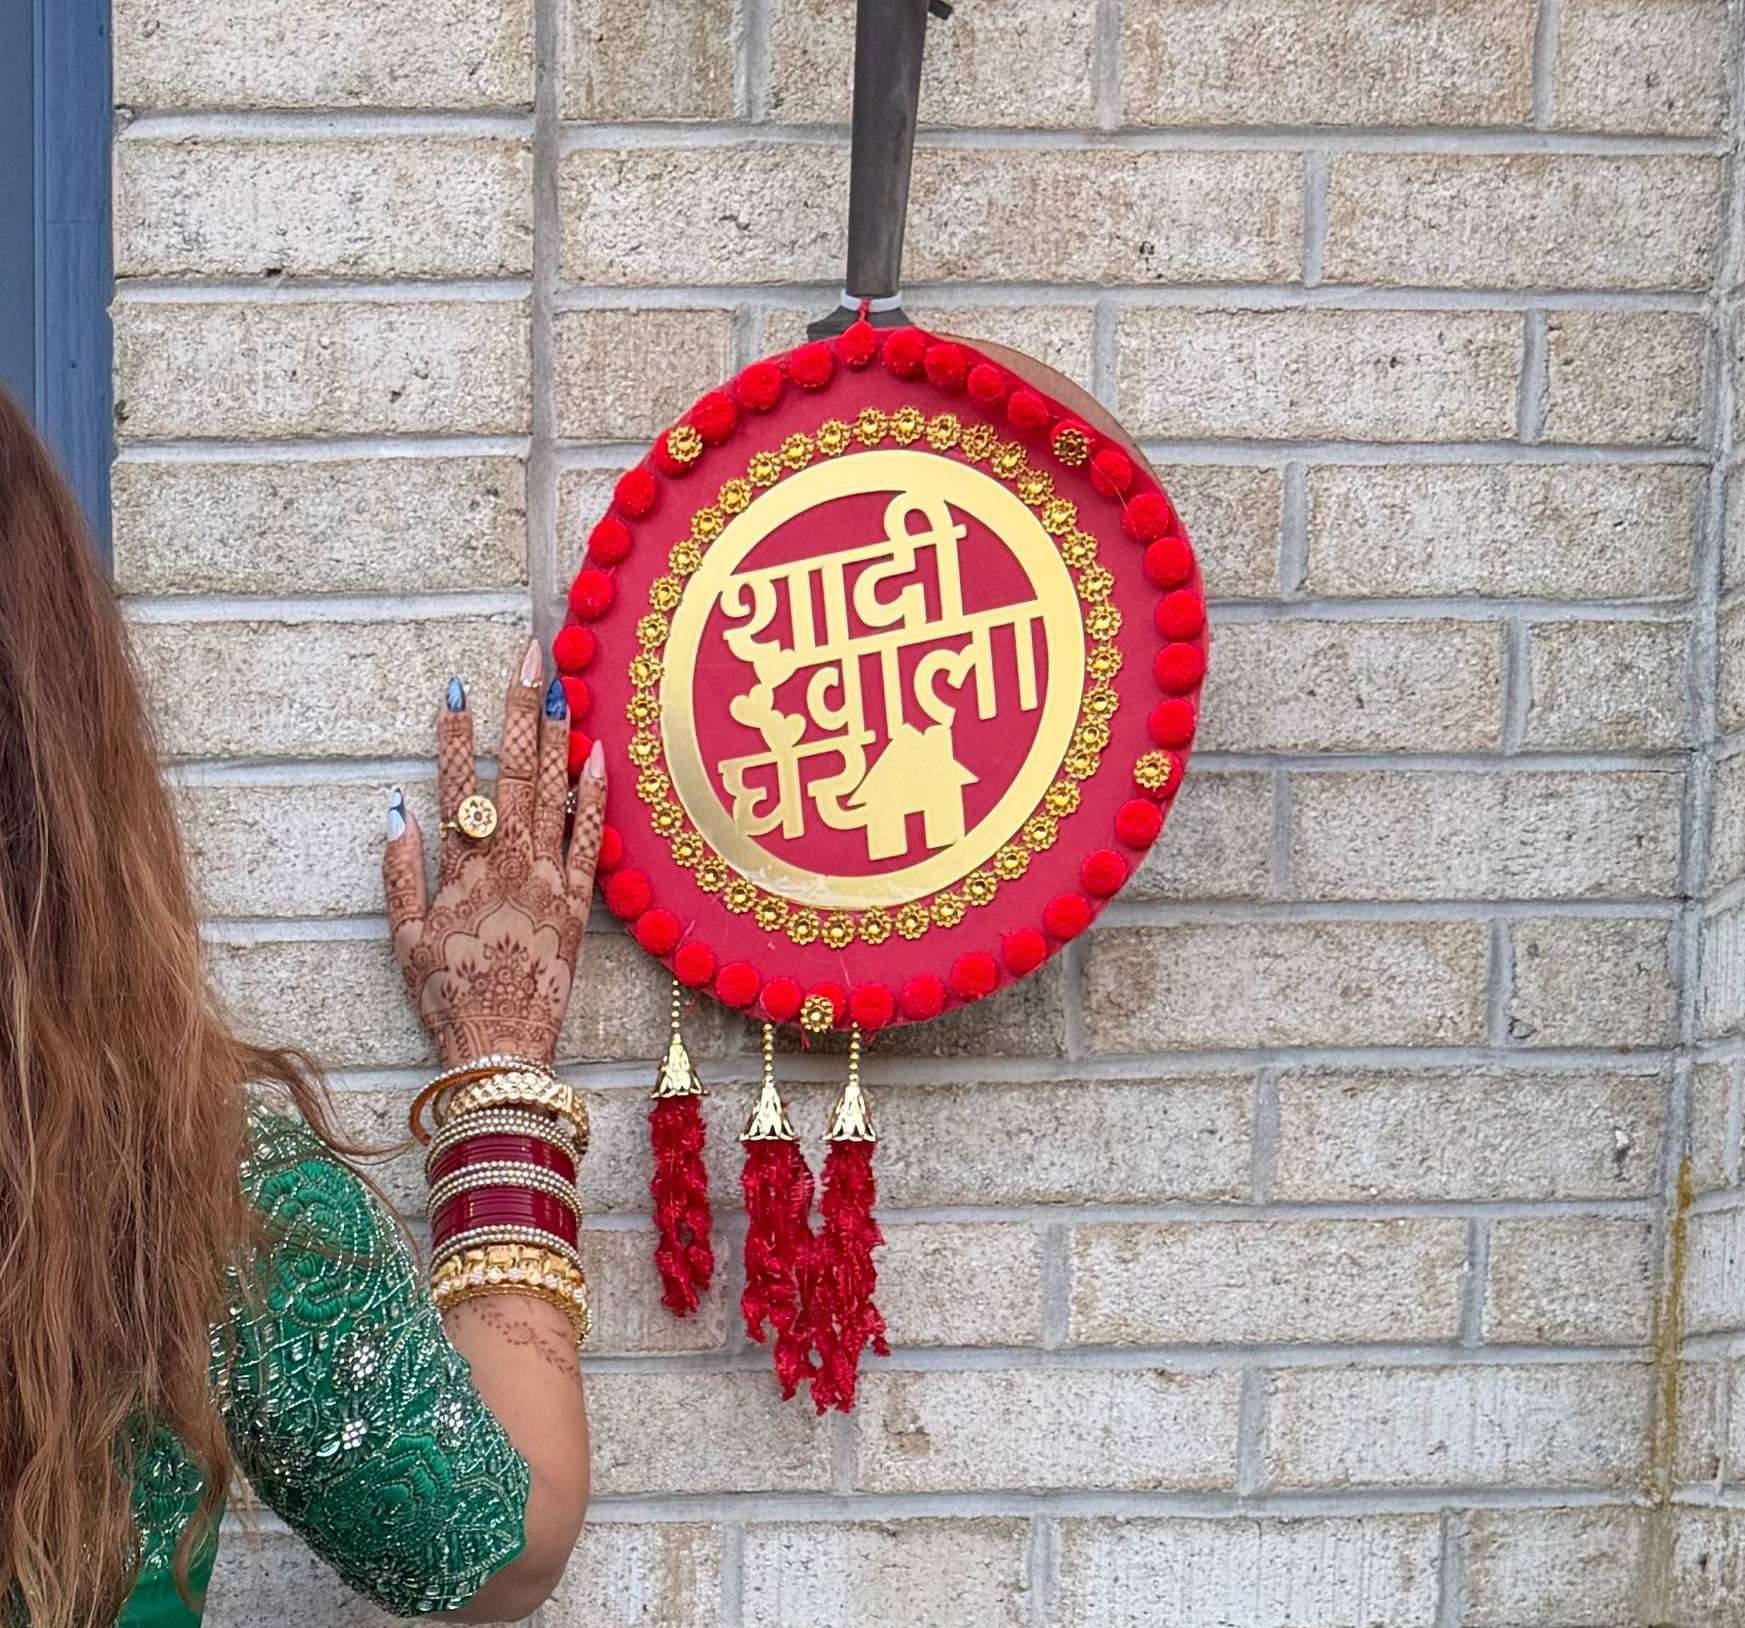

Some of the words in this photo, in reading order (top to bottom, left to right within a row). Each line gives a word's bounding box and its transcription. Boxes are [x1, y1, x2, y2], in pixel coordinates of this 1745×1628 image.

[720, 490, 967, 660] शादी
[799, 599, 1044, 739] वाला
[717, 729, 875, 840] घर
